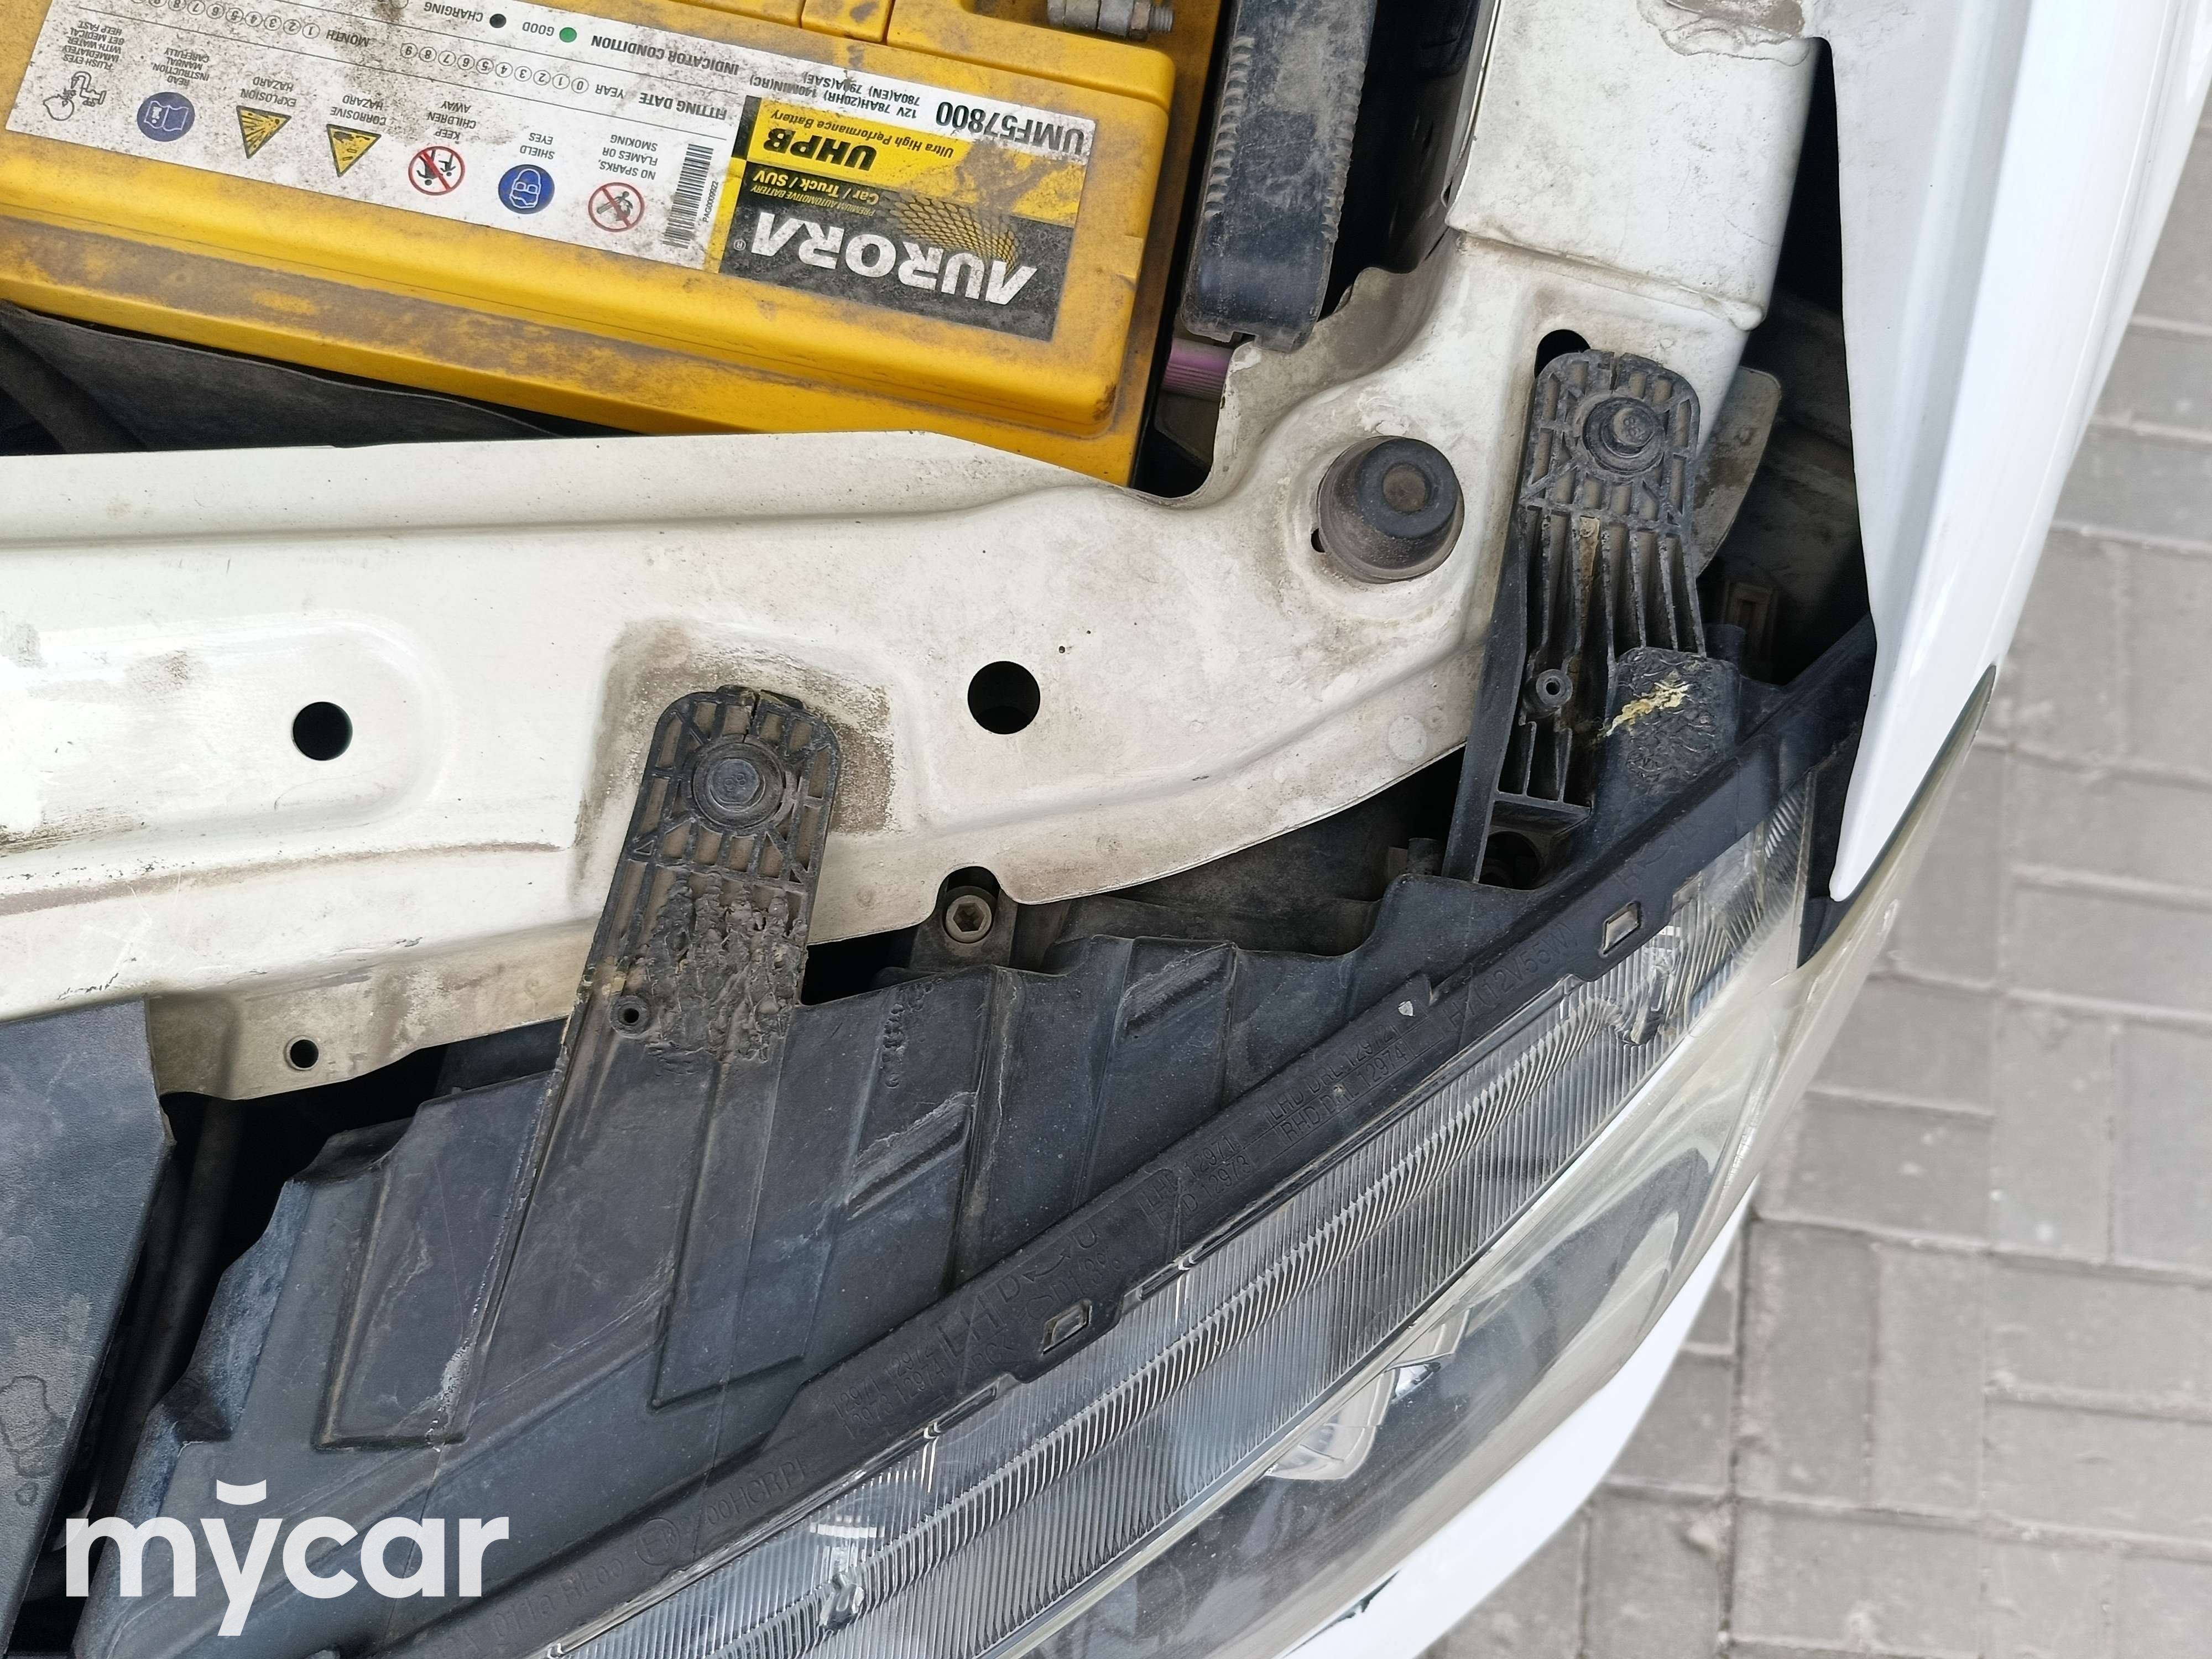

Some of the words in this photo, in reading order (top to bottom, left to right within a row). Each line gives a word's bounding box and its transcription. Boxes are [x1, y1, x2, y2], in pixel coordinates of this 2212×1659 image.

[423, 1, 483, 23] CHARGING
[69, 27, 107, 42] MEDICAL
[101, 24, 122, 36] HELP
[521, 20, 555, 36] GOOD
[108, 35, 124, 45] GET
[325, 28, 371, 47] MONTH
[61, 44, 119, 63] IMMEDIATELY
[97, 42, 121, 54] WITH
[163, 46, 210, 63] CAREFULLY
[590, 34, 665, 60] CONDITION
[62, 53, 84, 65] EYES
[85, 58, 113, 71] FLUSH
[165, 56, 202, 71] MANUAL
[666, 50, 739, 75] INDICATOR
[166, 75, 190, 86] READ
[252, 75, 294, 92] HAZARD
[239, 87, 296, 108] EXPLOSION
[594, 84, 624, 99] YEAR
[638, 92, 674, 109] DATE
[868, 85, 920, 106] 780A(EN)
[342, 93, 383, 111] HAZARD
[440, 99, 471, 114] AWAY
[675, 99, 727, 121] FITTING
[822, 90, 891, 113] 78AH(20HR)
[330, 105, 387, 126] CORROSIVE
[427, 111, 477, 129] CHILDREN
[769, 108, 815, 129] Battery
[896, 105, 917, 119] 12V
[434, 127, 461, 140] KEEP
[816, 119, 893, 145] Performance
[934, 100, 1086, 155] UMF57800
[528, 131, 554, 145] EYES
[609, 133, 658, 152] SMOKING
[894, 134, 922, 152] High
[519, 143, 555, 160] SHIELD
[601, 146, 617, 158] OR
[618, 149, 658, 166] FLAMES
[762, 125, 878, 172] UHPB
[922, 142, 954, 159] Ultra
[596, 158, 639, 177] SPARKS,
[639, 168, 656, 181] NO
[752, 168, 789, 187] SUV
[750, 183, 785, 199] BATTERY
[799, 177, 840, 197] Truck
[785, 190, 838, 209] AUTOMOTIVE
[852, 188, 879, 206] Car
[1279, 1103, 1323, 1141] RHD
[1354, 1042, 1410, 1089] 12974
[1265, 1084, 1307, 1121] LHD
